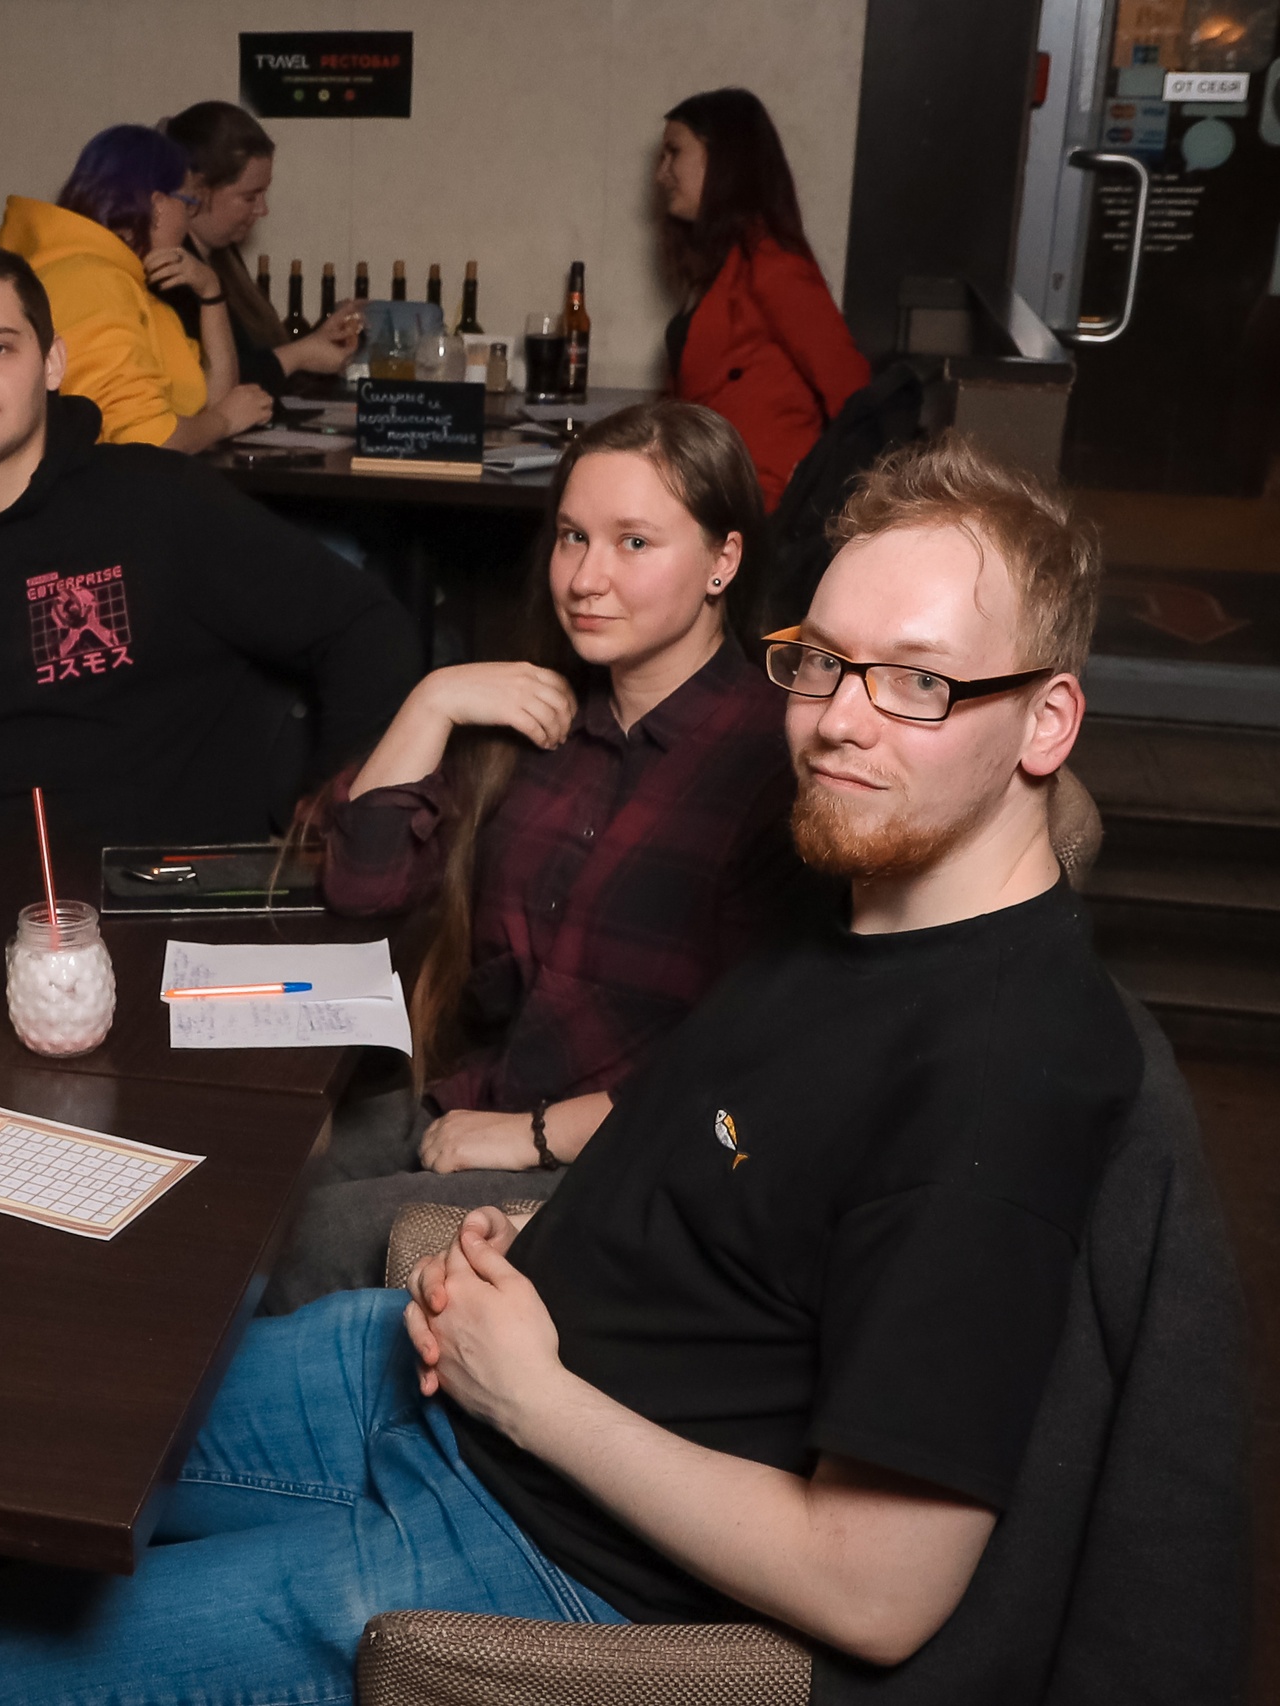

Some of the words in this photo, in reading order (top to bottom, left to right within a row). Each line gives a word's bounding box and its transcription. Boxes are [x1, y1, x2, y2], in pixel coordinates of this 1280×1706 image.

[255, 54, 310, 69] TRAVEL
[1172, 80, 1193, 94] ОТ
[36, 646, 134, 685] コスモス
